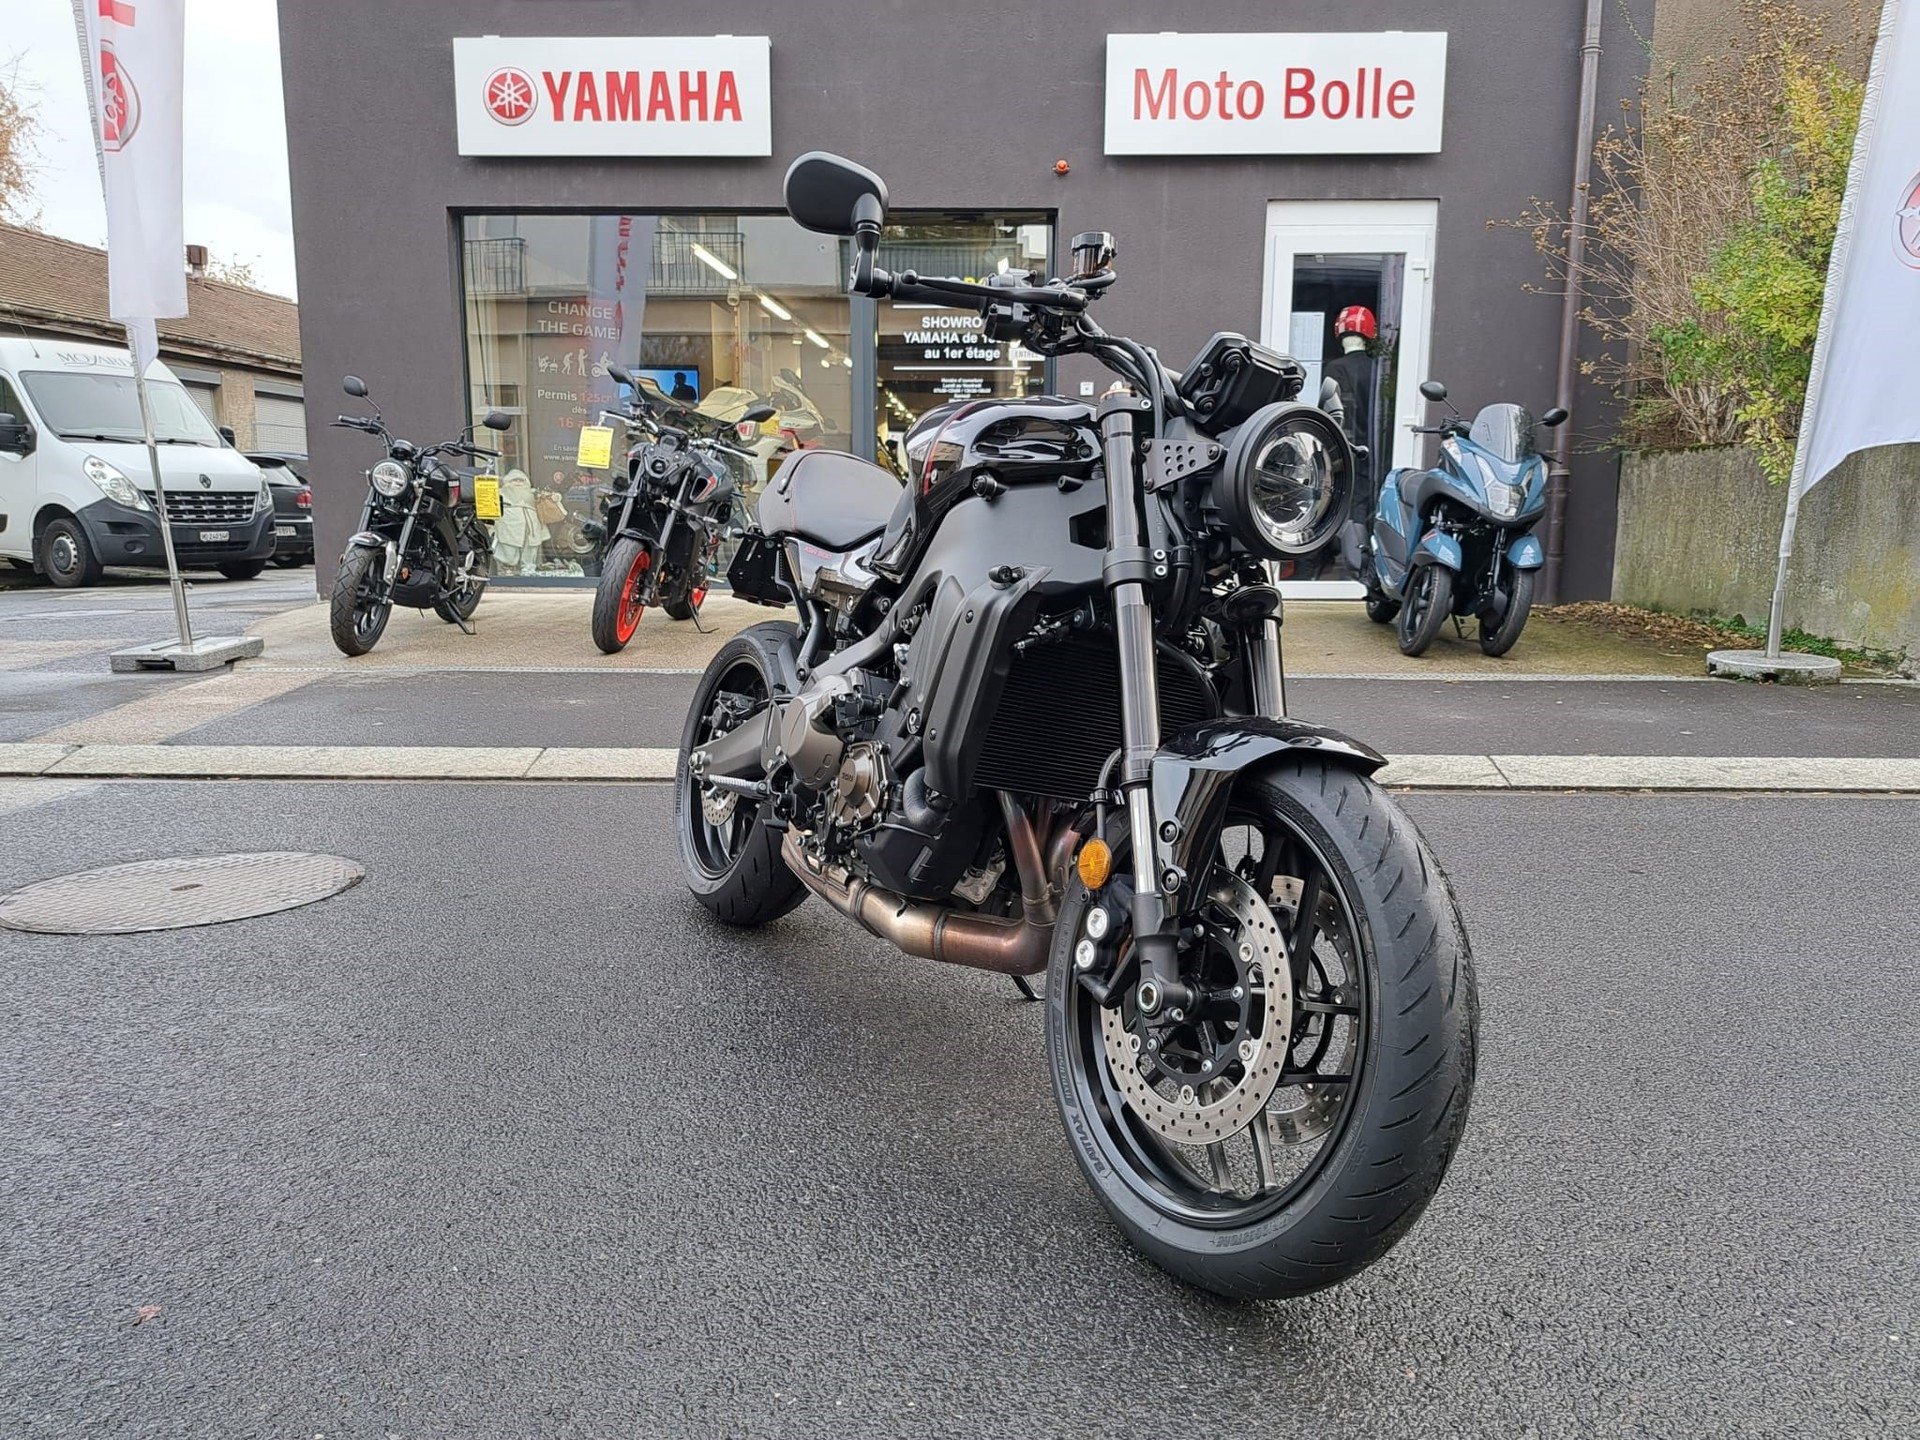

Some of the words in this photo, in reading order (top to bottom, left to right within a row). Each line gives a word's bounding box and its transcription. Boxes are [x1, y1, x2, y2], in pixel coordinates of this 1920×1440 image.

[542, 71, 743, 121] YAMAHA
[1133, 67, 1265, 121] Moto
[1283, 67, 1415, 120] Bolle
[548, 301, 612, 319] CHANGE
[922, 316, 983, 328] SHOWRO
[538, 320, 569, 334] THE
[572, 323, 621, 340] GAME!
[903, 332, 960, 344] YAMAHA
[962, 332, 978, 344] de
[924, 349, 940, 359] au
[944, 348, 962, 359] 1er
[966, 347, 1000, 361] étage
[538, 389, 577, 401] Permis
[571, 405, 587, 415] dès
[558, 416, 574, 429] 16
[1071, 1113, 1106, 1174] BATTLAX
